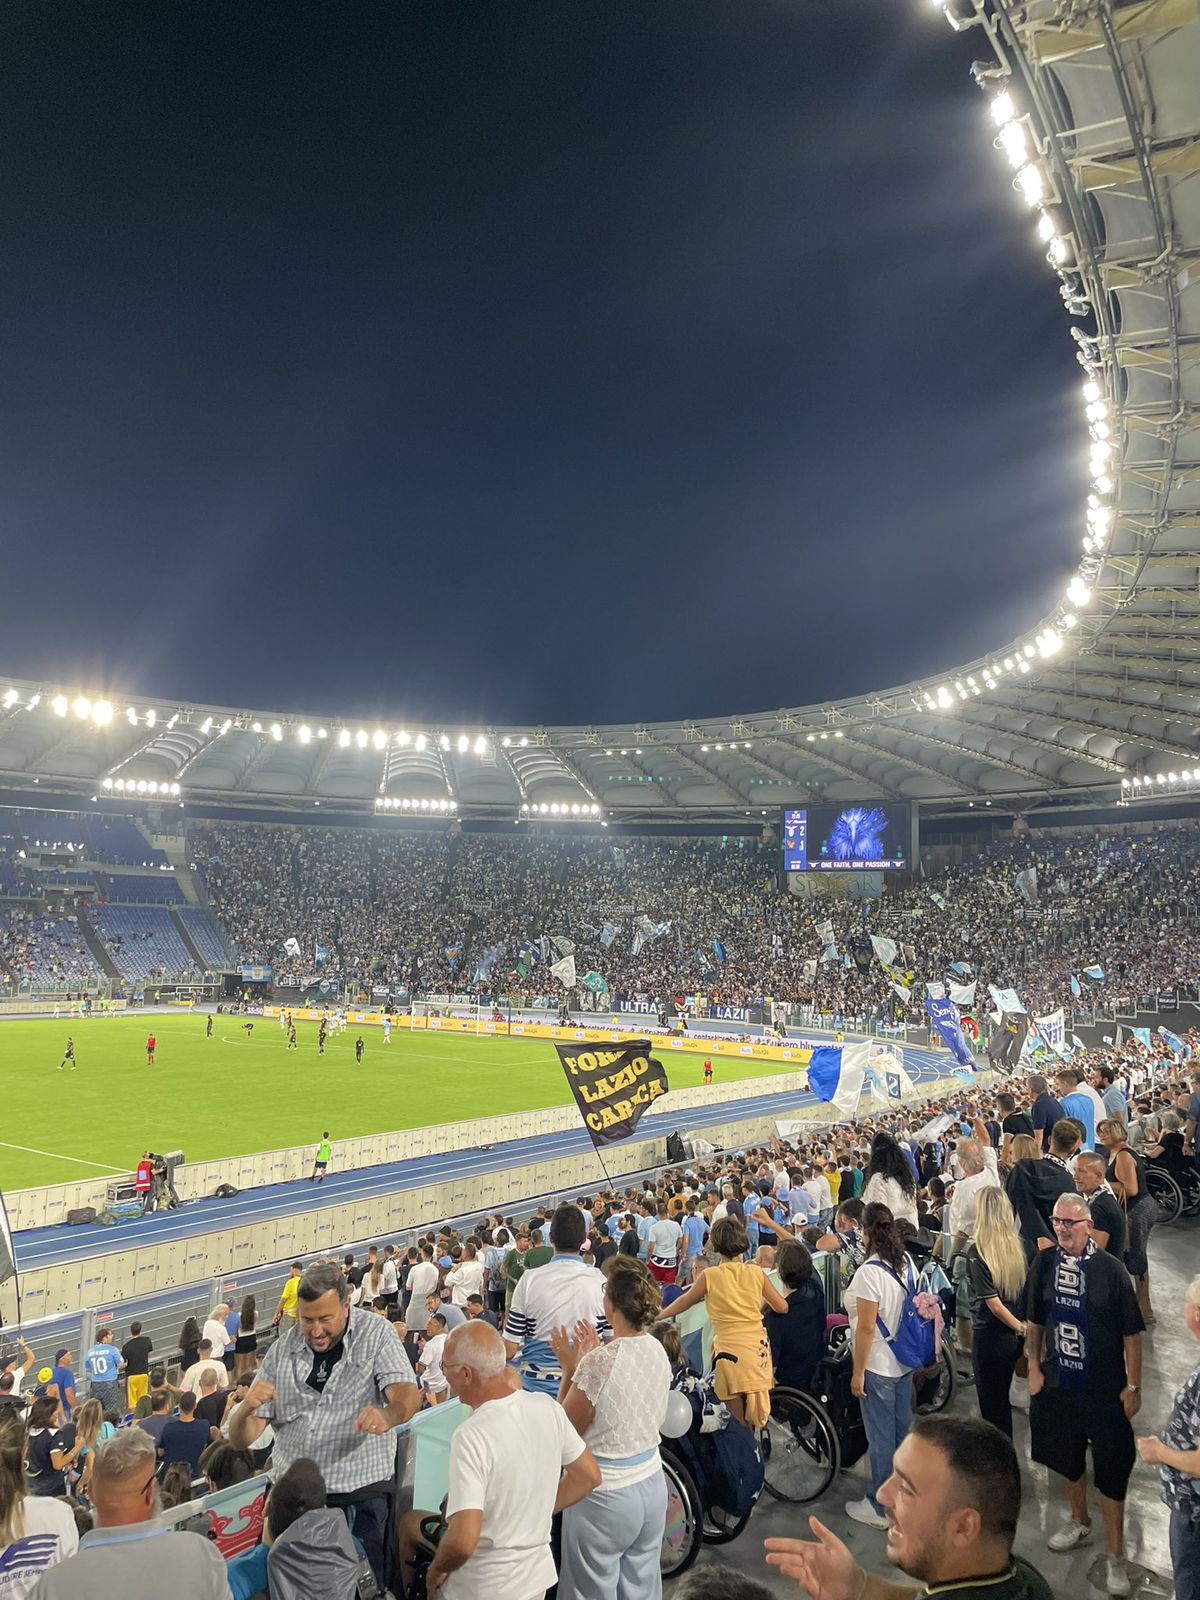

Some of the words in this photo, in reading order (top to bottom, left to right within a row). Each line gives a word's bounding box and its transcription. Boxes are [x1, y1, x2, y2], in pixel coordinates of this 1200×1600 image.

[799, 826, 805, 837] 2
[306, 897, 341, 906] GATE
[578, 1057, 649, 1103] LAZIO
[1055, 1296, 1080, 1308] LAZIO
[90, 1356, 107, 1375] 10
[1059, 1357, 1083, 1370] LAZIO
